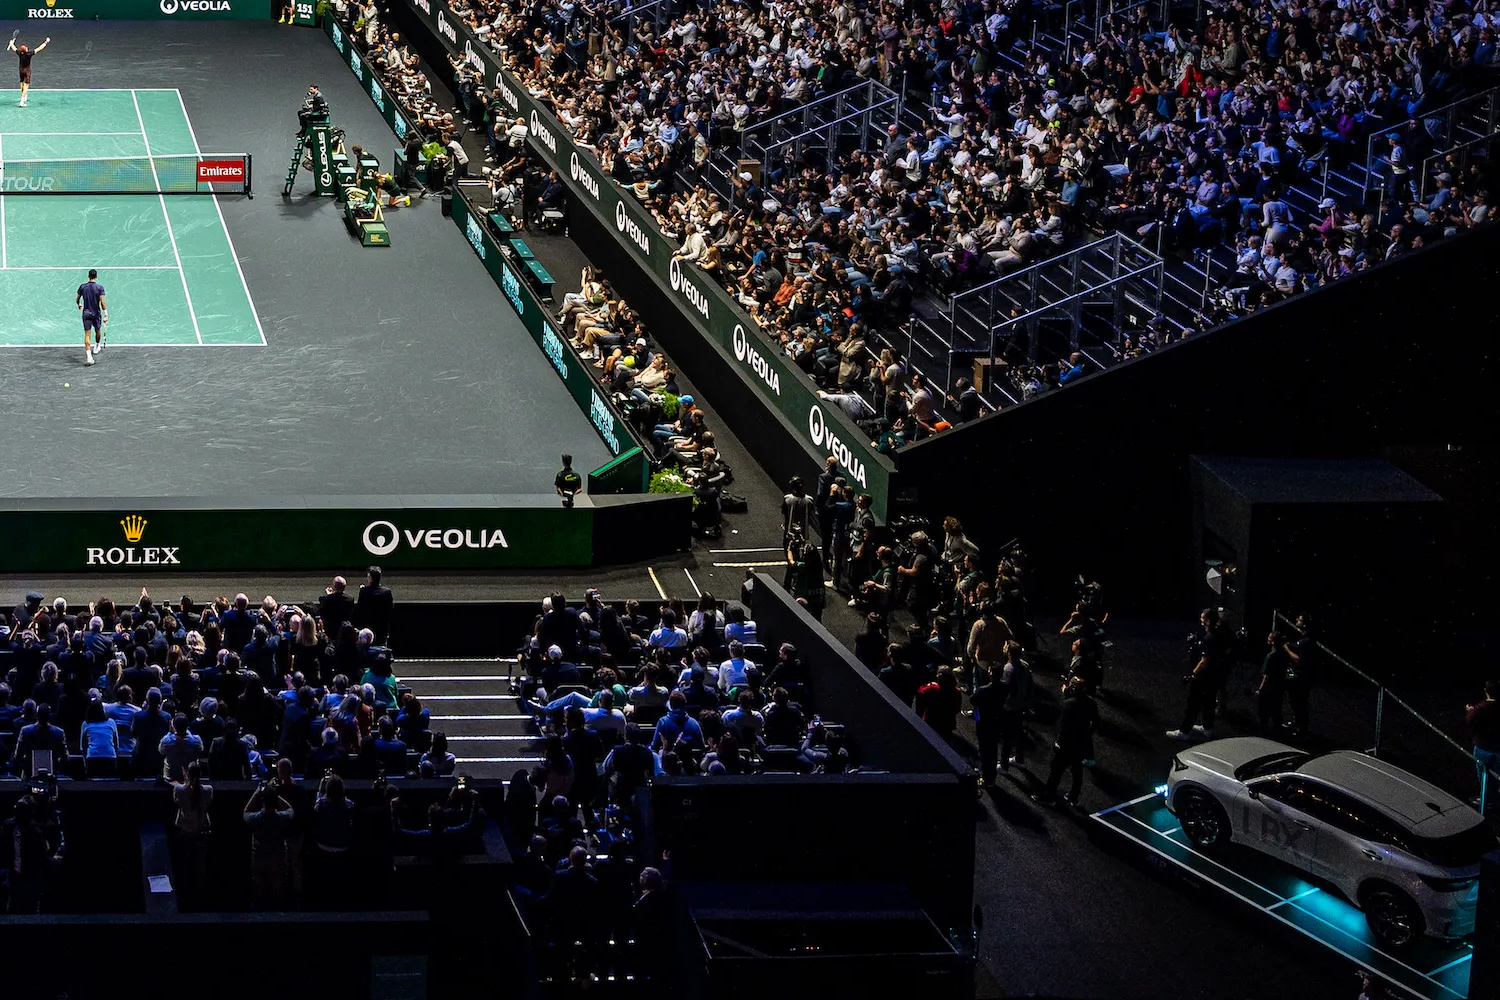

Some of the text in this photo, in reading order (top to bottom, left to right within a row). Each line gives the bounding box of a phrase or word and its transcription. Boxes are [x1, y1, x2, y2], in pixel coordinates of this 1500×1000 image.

[28, 8, 74, 19] ROLEX
[180, 0, 231, 12] VEOLIA
[297, 3, 313, 14] 151
[538, 120, 557, 154] VEOLIA
[318, 131, 329, 172] LEXUS
[4, 177, 56, 191] TOUR
[200, 166, 243, 177] Emirates
[579, 164, 600, 201] VEOLIA
[625, 214, 650, 256] VEOLIA
[680, 273, 710, 320] VEOLIA
[746, 342, 782, 397] VEOLIA
[825, 426, 867, 490] VEOLIA
[404, 528, 508, 550] VEOLIA
[86, 548, 181, 566] ROLEX
